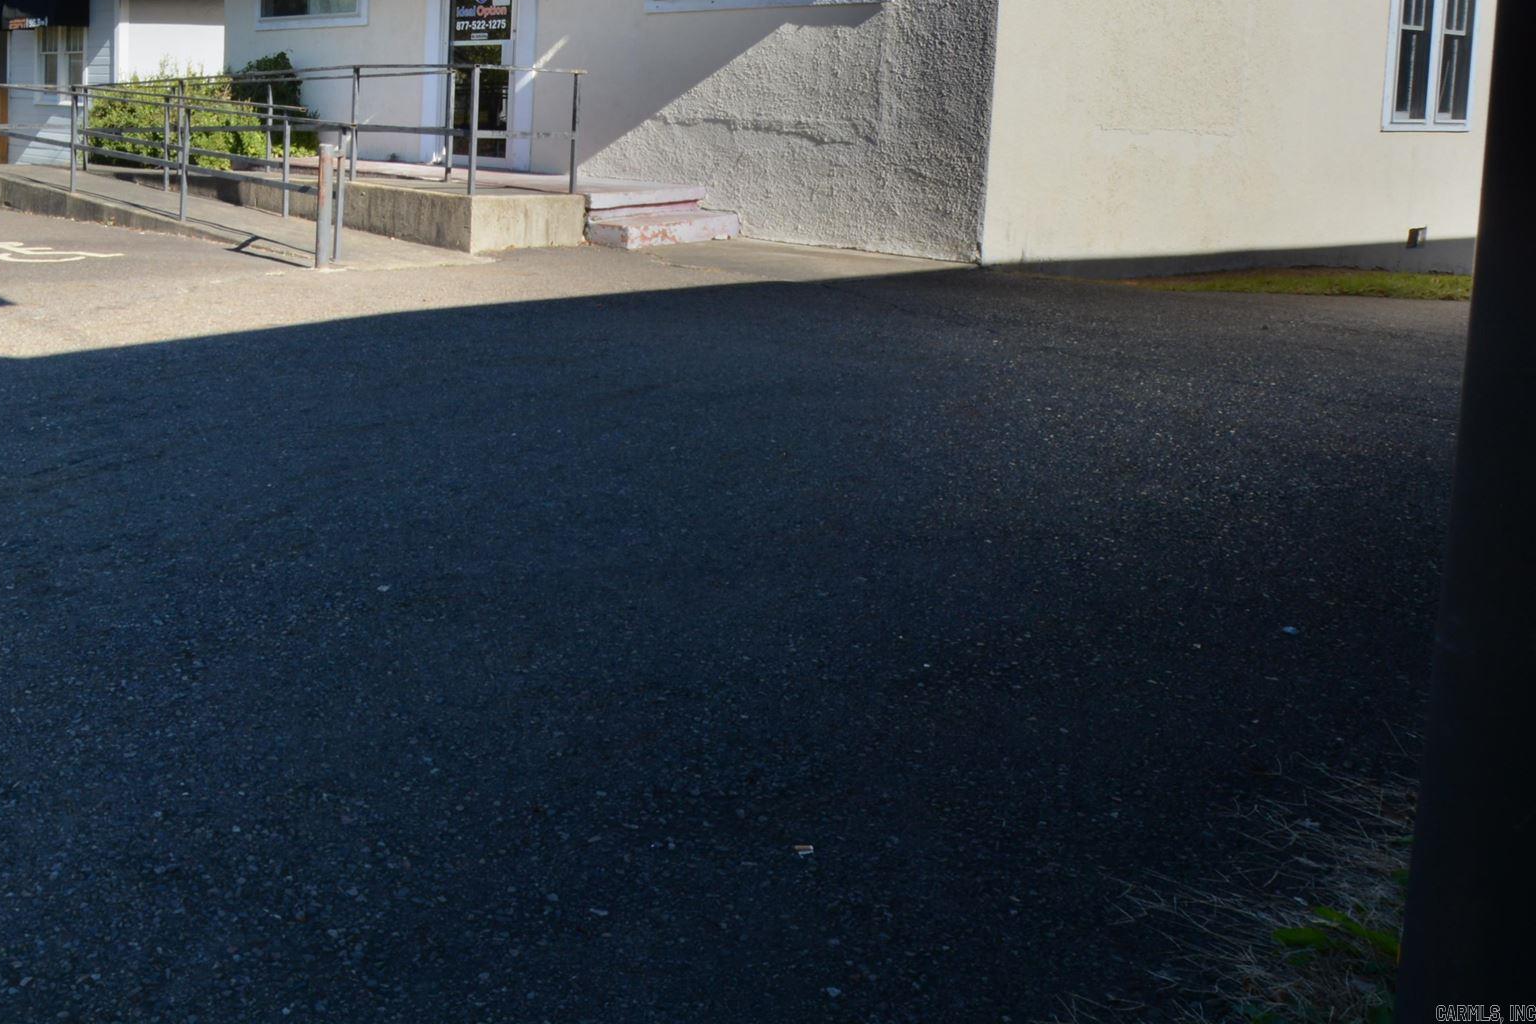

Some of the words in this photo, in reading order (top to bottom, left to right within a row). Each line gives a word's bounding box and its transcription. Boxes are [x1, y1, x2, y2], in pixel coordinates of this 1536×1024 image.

[456, 5, 476, 18] Ideal
[476, 5, 508, 18] Option
[455, 19, 507, 31] 877-522-1275
